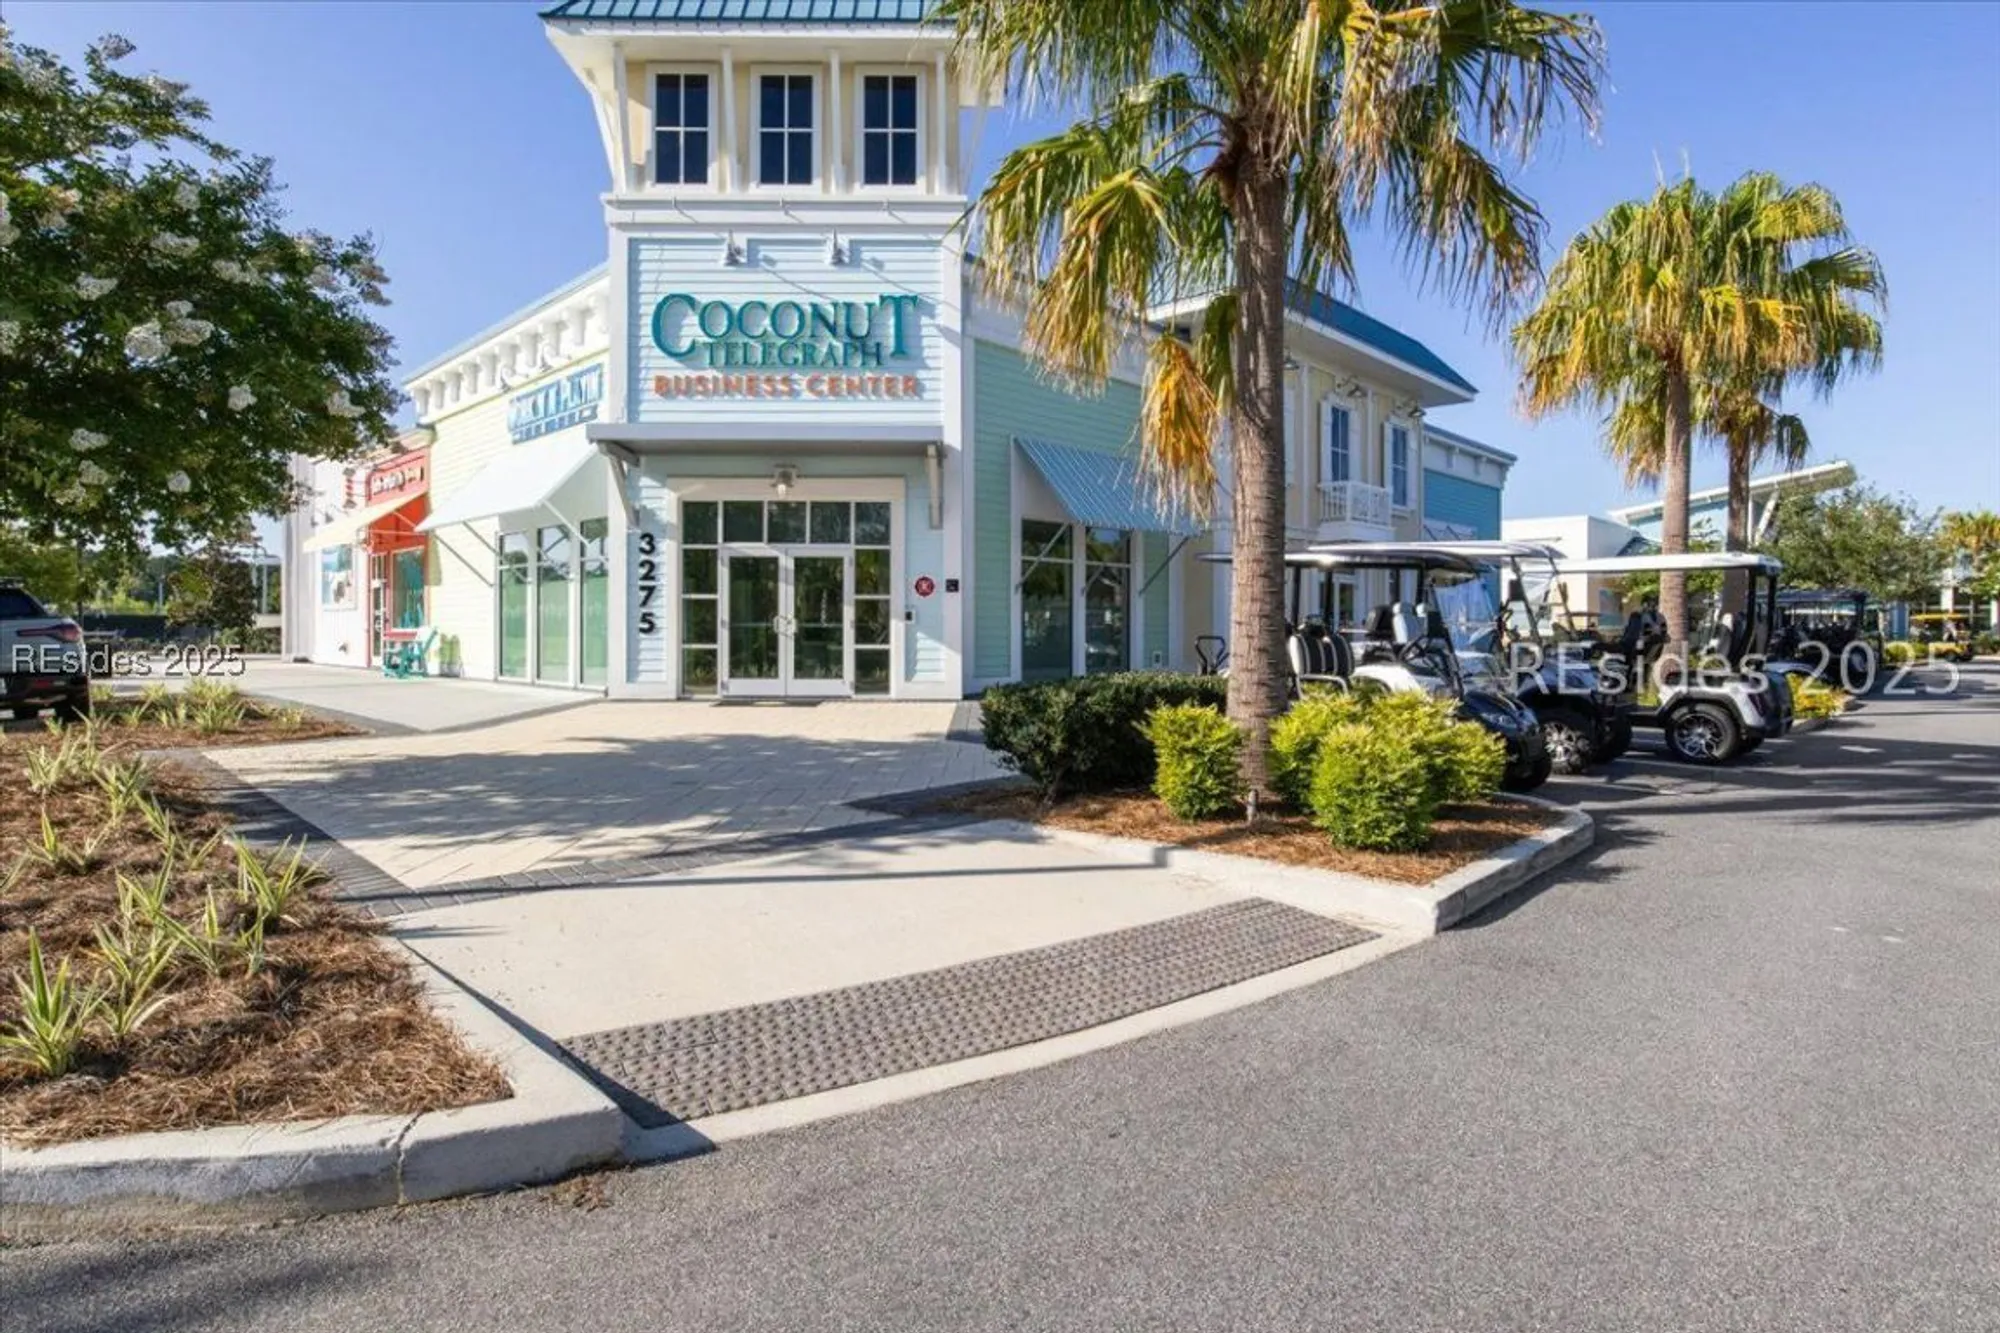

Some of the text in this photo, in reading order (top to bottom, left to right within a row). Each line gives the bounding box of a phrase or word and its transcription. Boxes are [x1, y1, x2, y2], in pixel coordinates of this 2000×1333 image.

[652, 292, 918, 359] COCONUT
[703, 341, 885, 368] TELEGRAPH
[654, 374, 917, 397] BUSINESS CENTER
[639, 532, 656, 634] 3275
